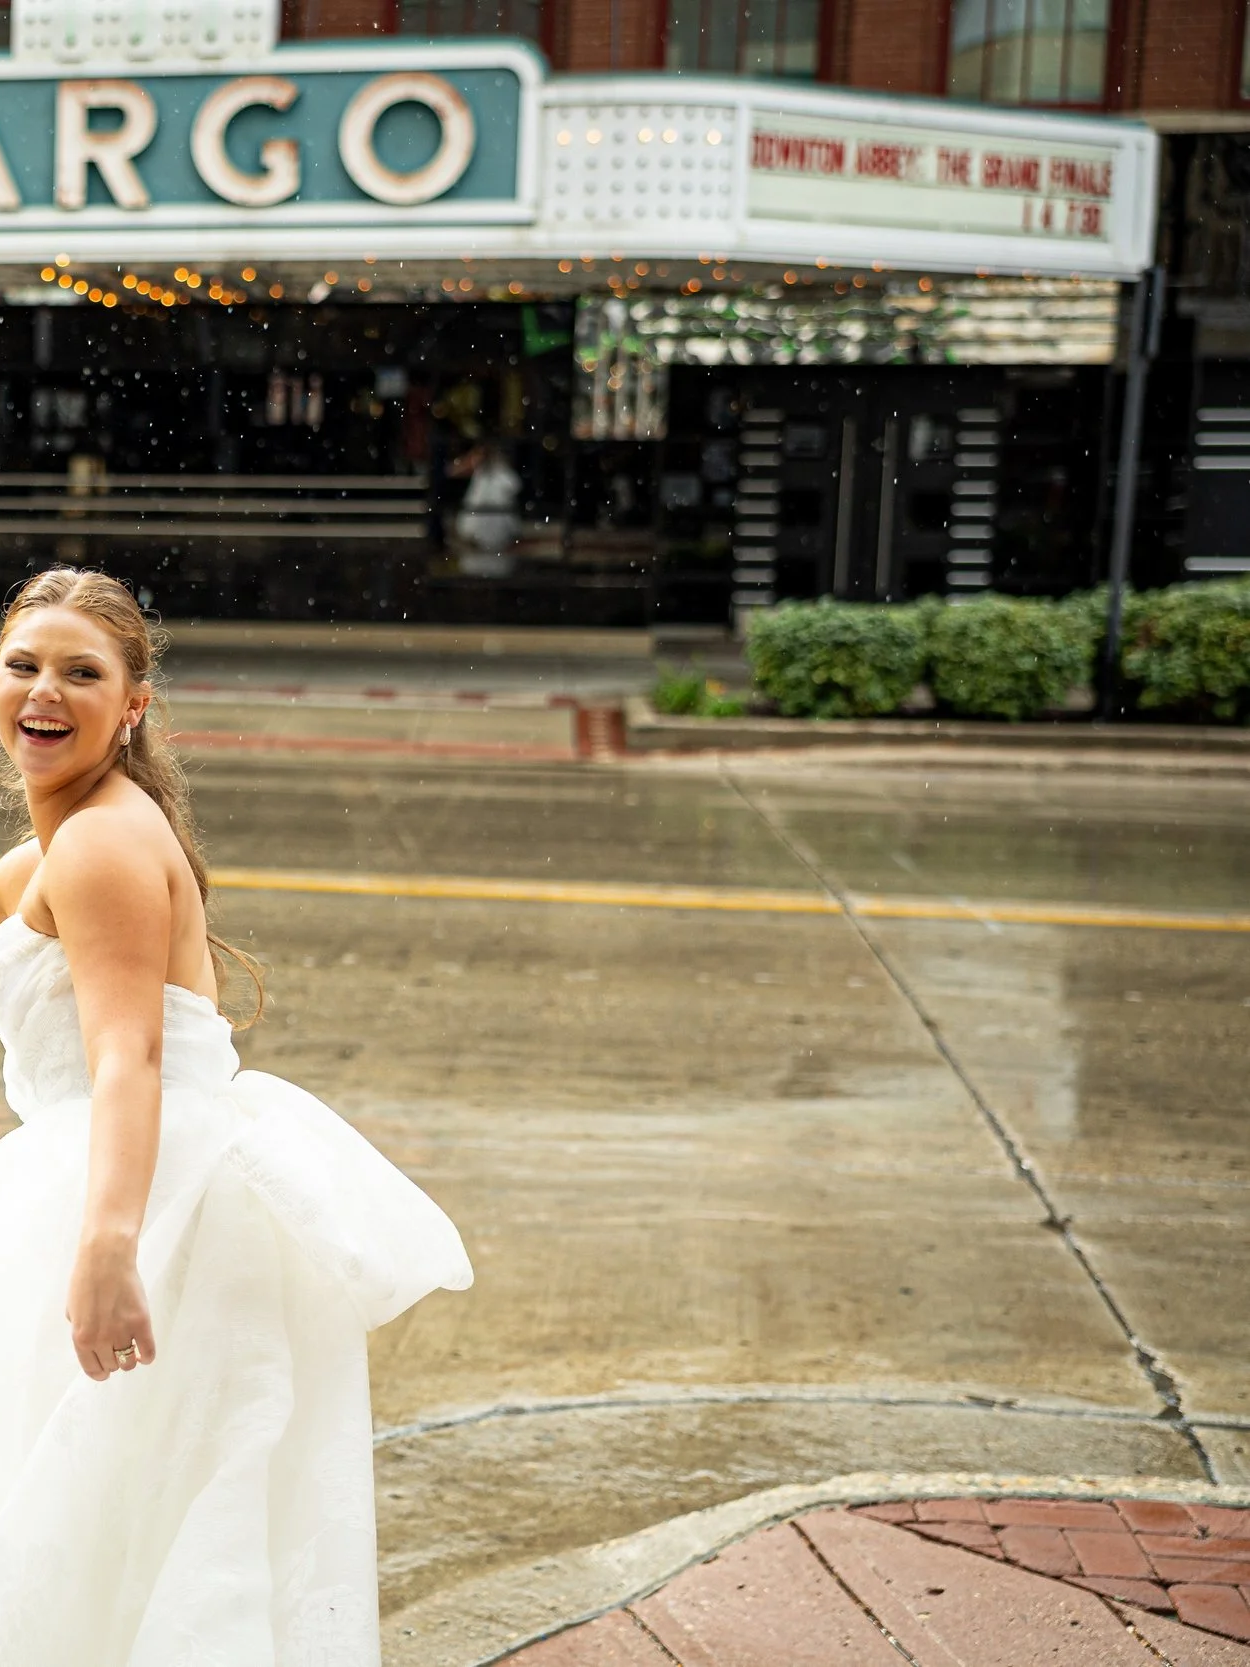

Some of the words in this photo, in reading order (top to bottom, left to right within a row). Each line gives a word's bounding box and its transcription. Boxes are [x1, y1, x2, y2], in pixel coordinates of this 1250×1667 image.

[751, 133, 845, 176] DOWNTON
[936, 146, 971, 187] THE
[981, 152, 1043, 193] GRAND
